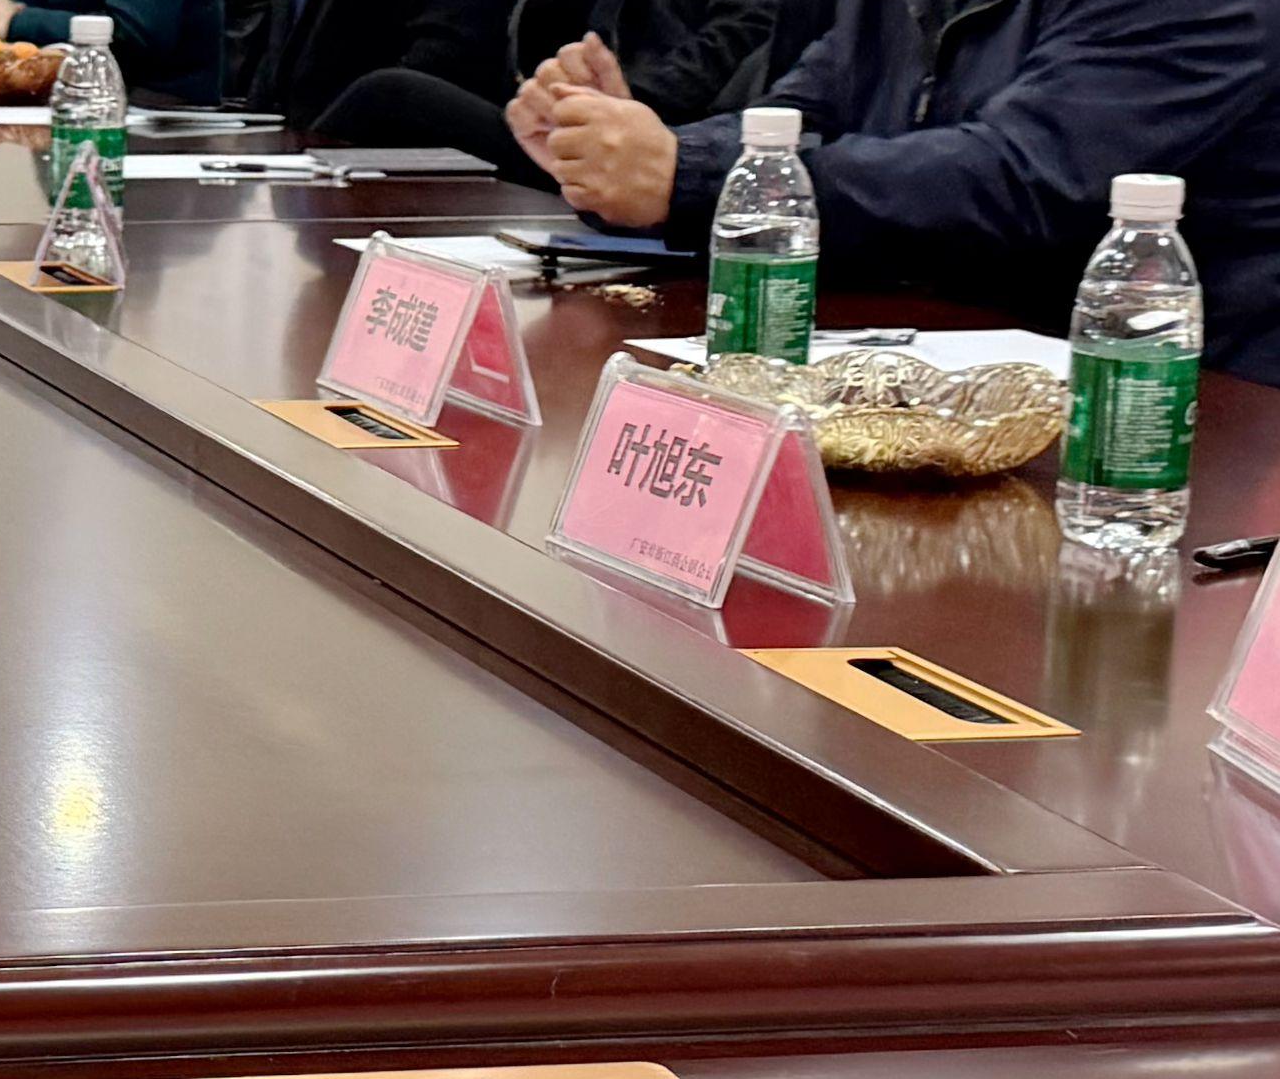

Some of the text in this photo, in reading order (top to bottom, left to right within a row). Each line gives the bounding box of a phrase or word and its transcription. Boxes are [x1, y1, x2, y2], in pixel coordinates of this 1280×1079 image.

[365, 284, 440, 352] 李成建
[606, 422, 723, 508] 叶旭东
